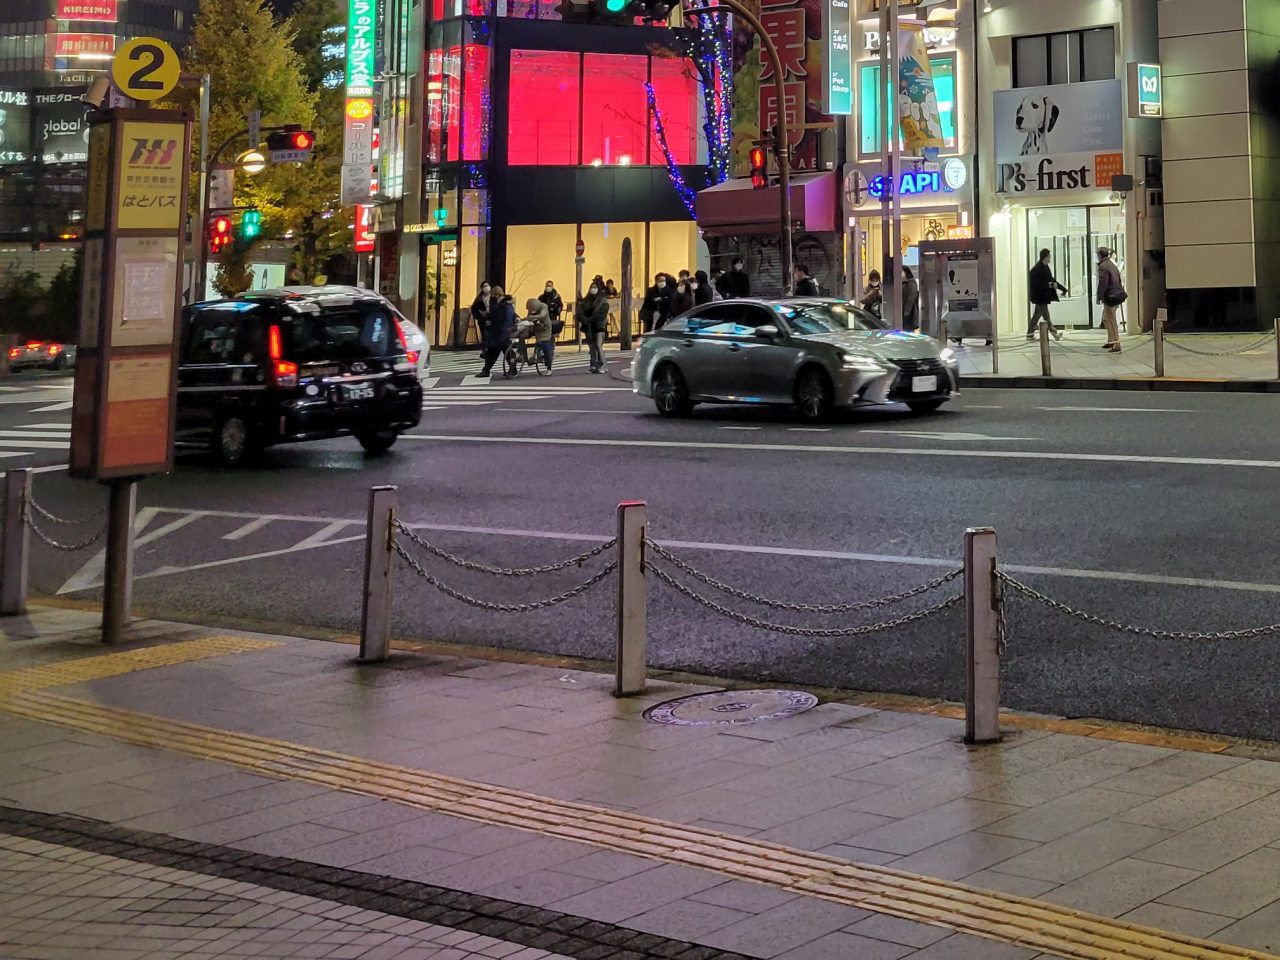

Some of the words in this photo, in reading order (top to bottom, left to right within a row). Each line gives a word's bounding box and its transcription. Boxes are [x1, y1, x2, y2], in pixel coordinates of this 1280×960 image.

[127, 43, 165, 91] 2
[832, 78, 845, 86] Pet
[832, 85, 849, 95] Shop
[996, 157, 1091, 194] P's-first
[122, 194, 177, 208] はとバス
